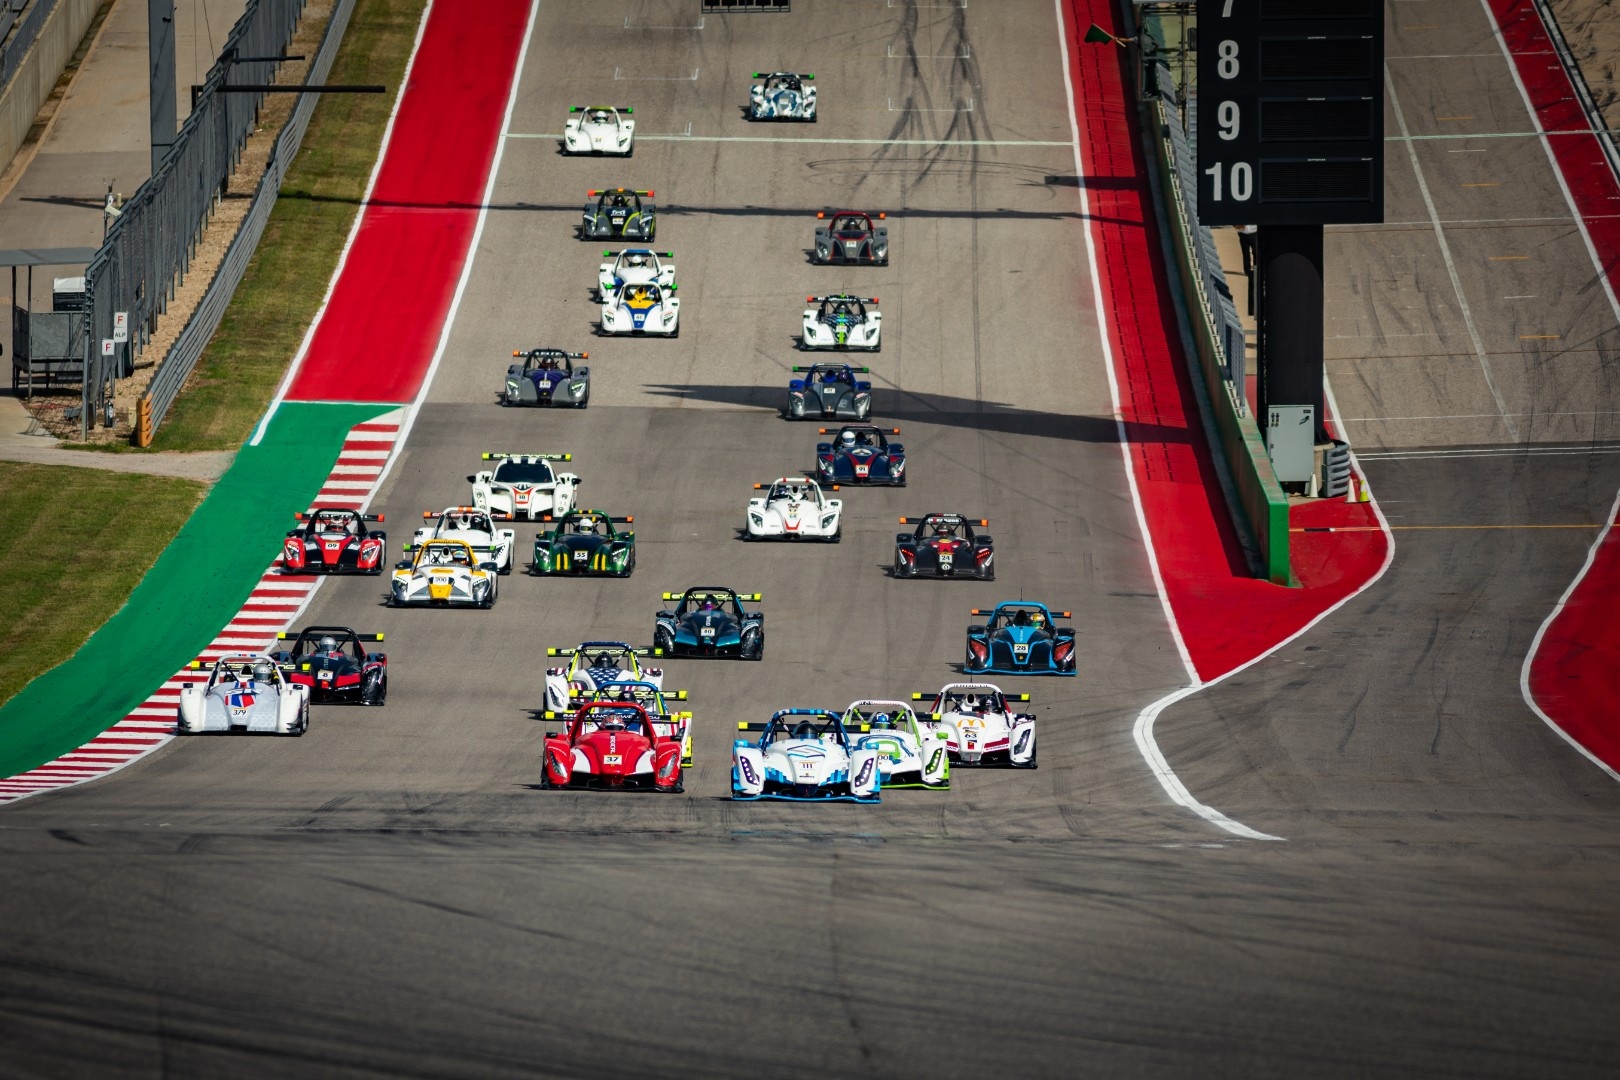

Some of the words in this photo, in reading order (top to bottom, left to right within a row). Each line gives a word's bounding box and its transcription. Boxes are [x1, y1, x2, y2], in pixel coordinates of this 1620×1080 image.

[1218, 40, 1239, 79] 8
[1218, 101, 1240, 140] 9
[1205, 162, 1253, 201] 10
[117, 315, 124, 324] F
[105, 343, 112, 352] F
